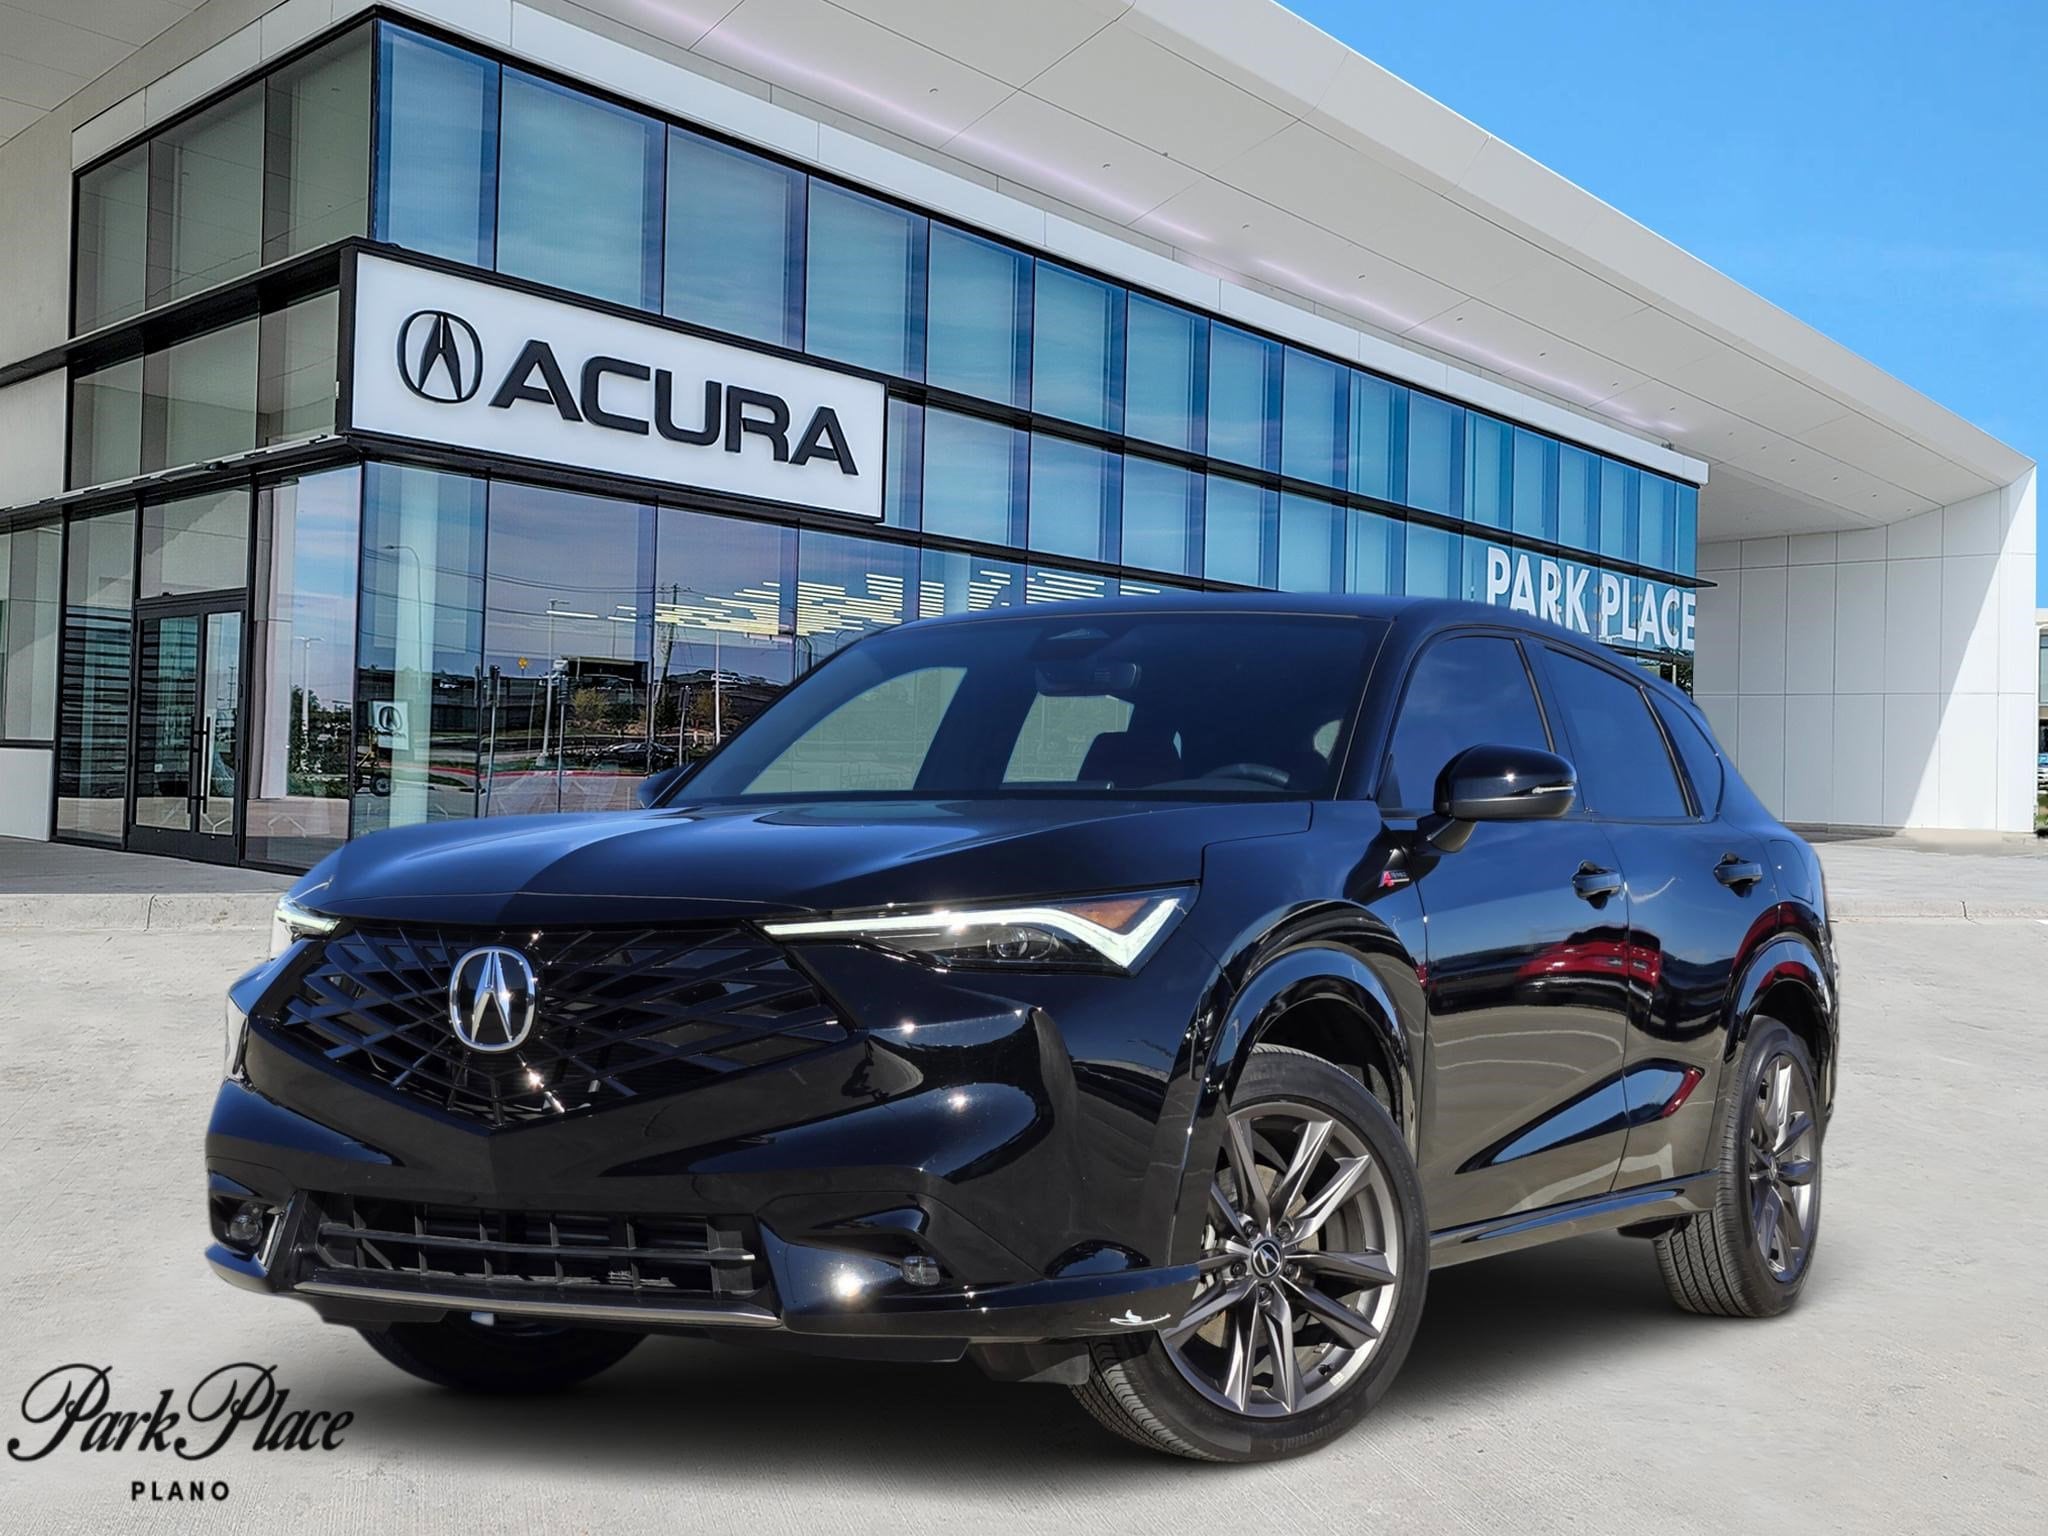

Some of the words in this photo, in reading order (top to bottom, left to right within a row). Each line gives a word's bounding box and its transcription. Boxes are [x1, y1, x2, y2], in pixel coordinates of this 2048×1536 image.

[488, 339, 859, 475] ACURA
[1487, 547, 1590, 633] PARK
[1601, 573, 1696, 650] PLACE
